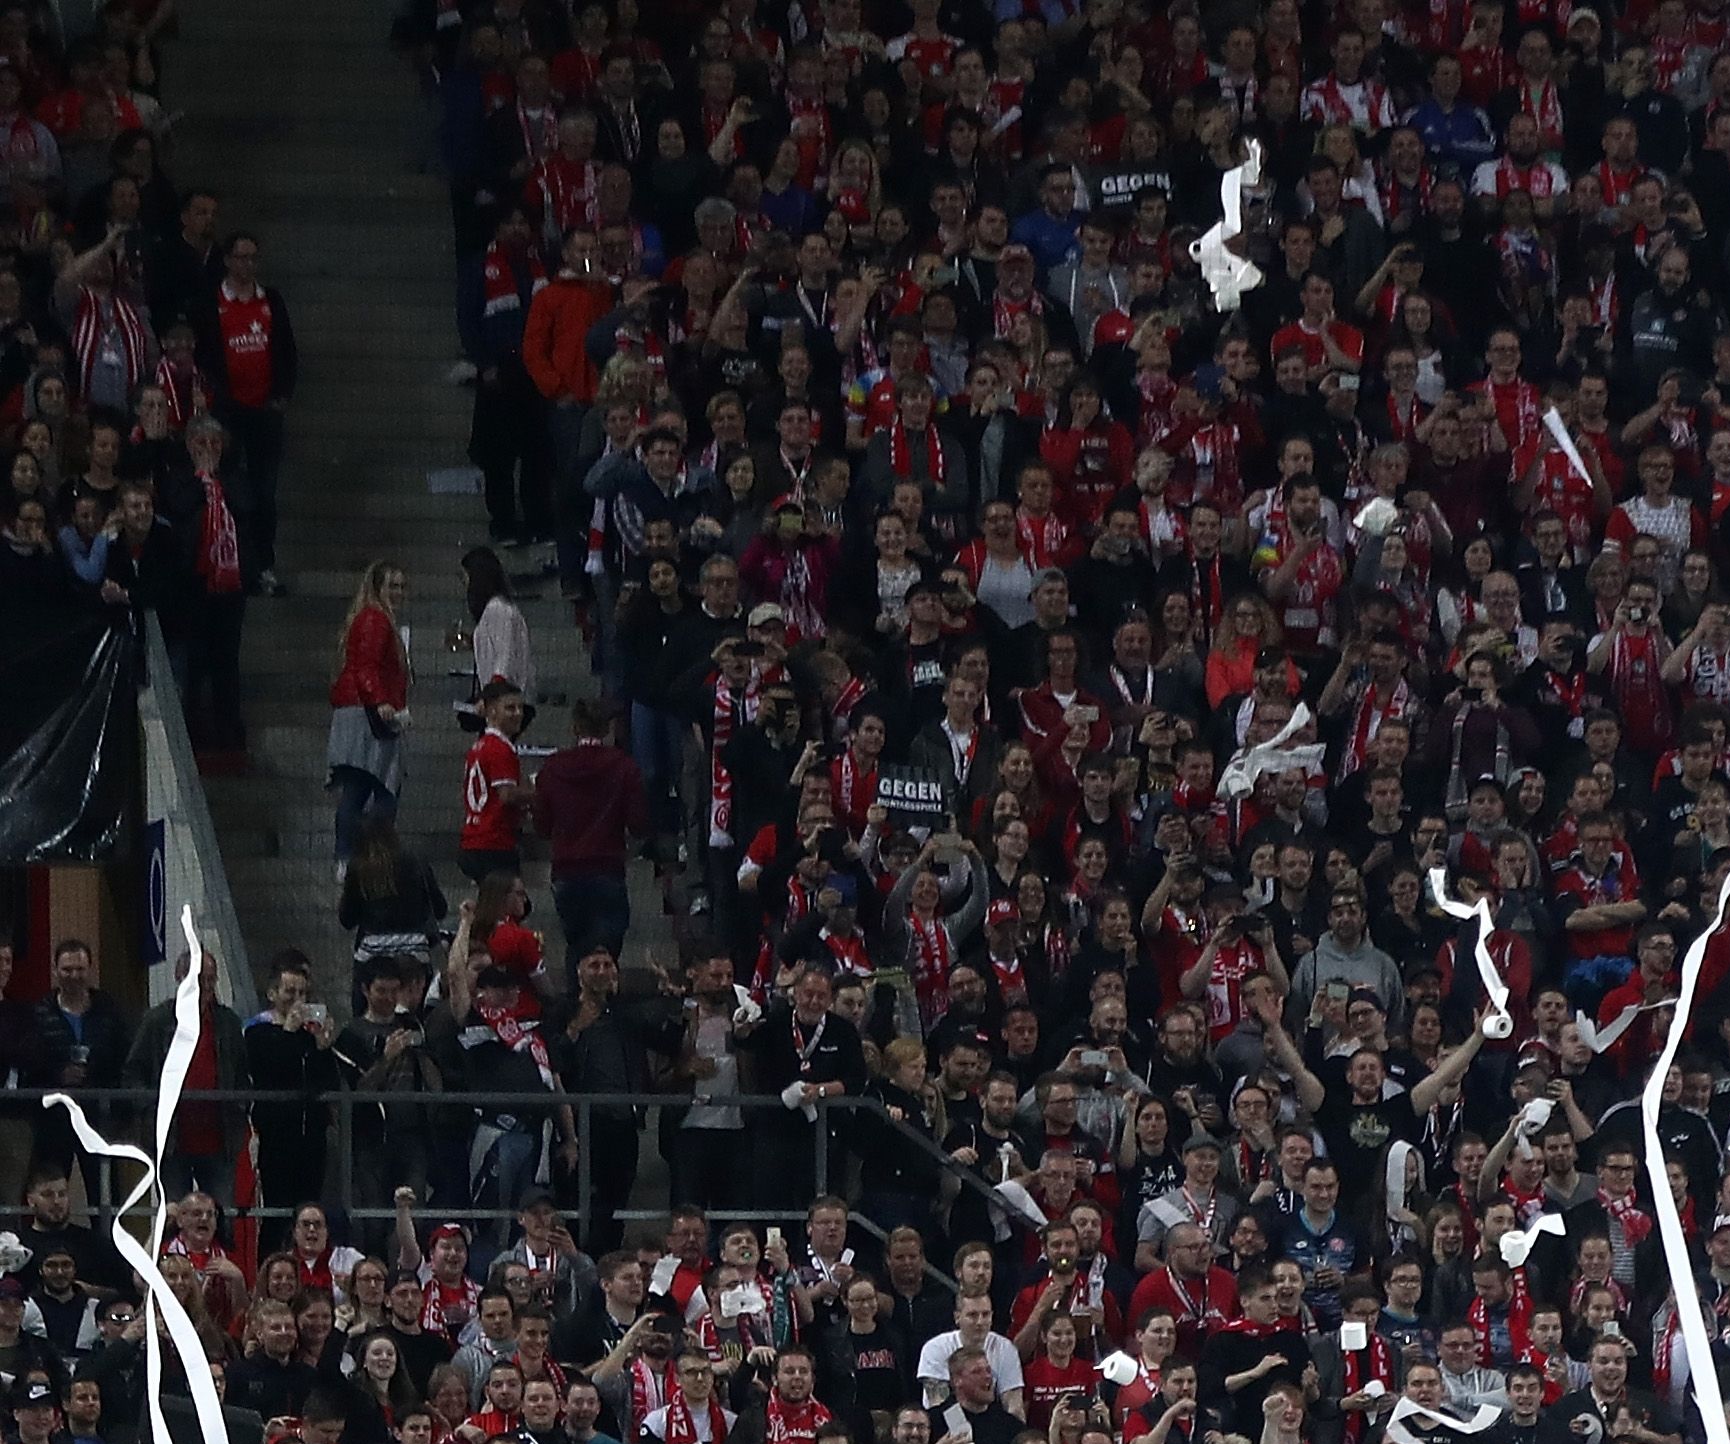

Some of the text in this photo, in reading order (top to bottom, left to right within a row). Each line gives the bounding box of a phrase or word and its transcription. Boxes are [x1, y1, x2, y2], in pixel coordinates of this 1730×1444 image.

[1100, 174, 1171, 198] GEGEN
[464, 759, 488, 813] 0
[878, 779, 943, 803] GEGEN
